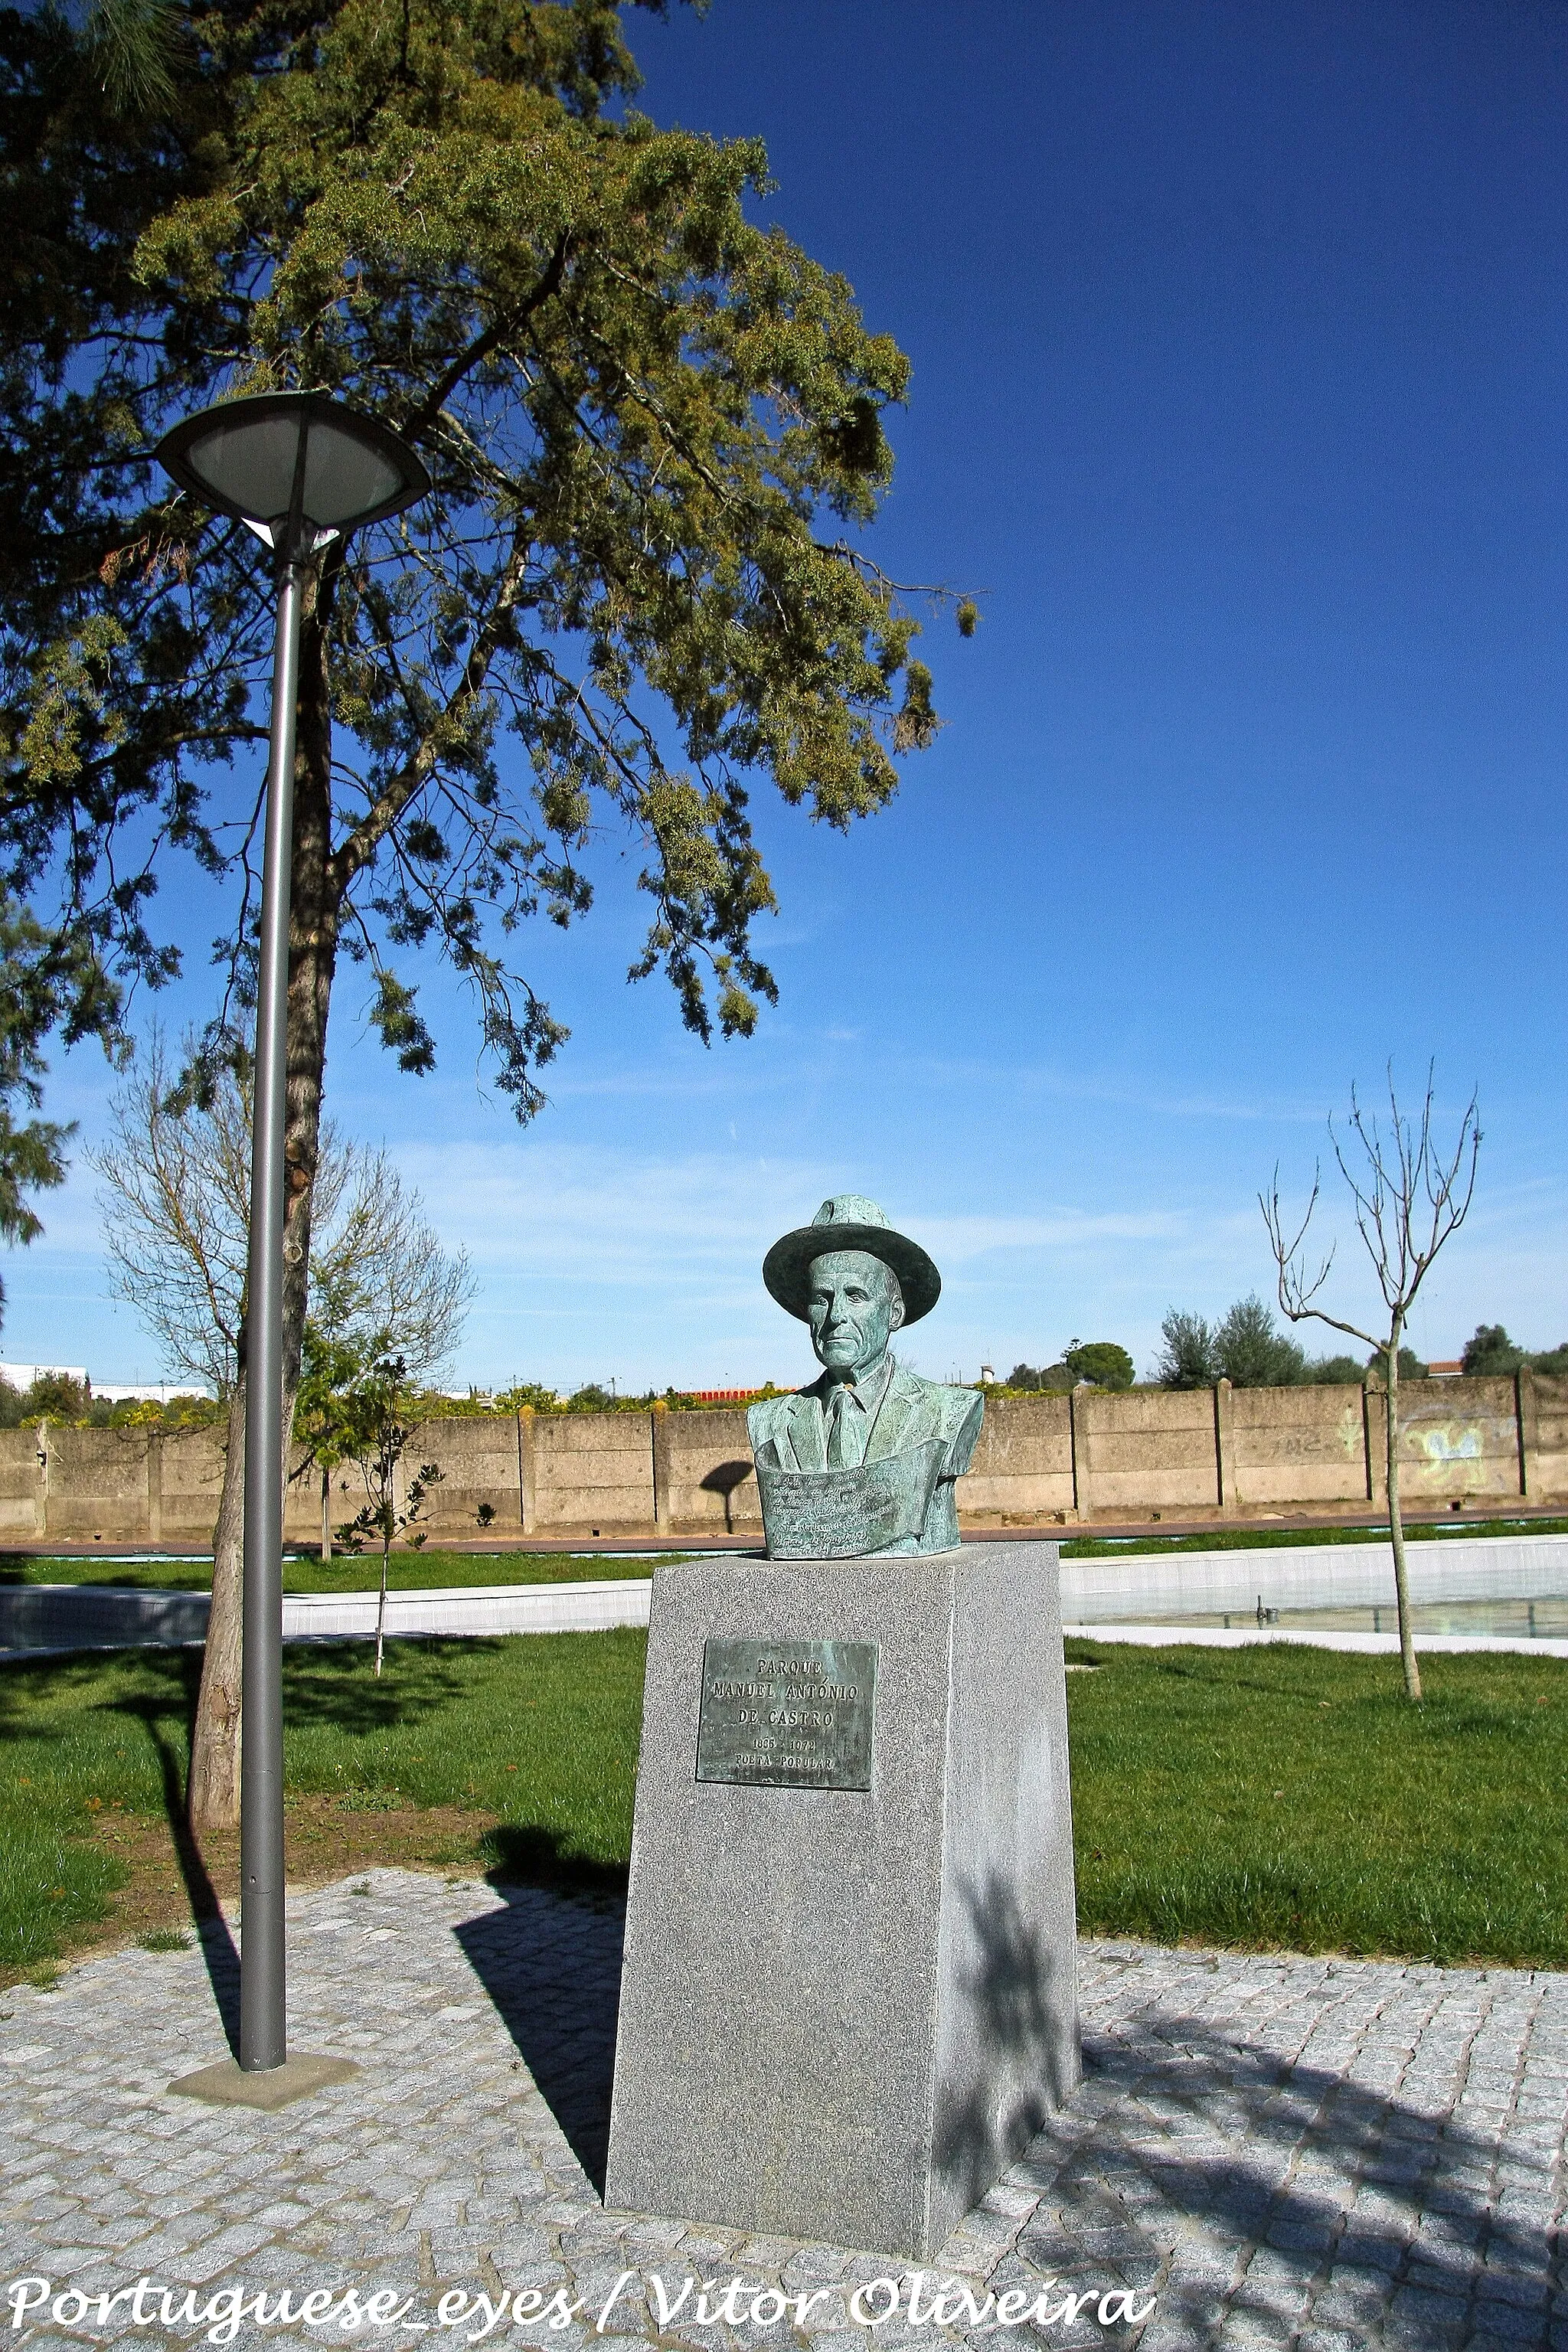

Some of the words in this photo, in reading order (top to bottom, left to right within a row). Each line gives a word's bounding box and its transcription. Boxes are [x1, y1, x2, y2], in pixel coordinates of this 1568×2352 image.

[758, 1658, 824, 1674] PARQUE
[714, 1681, 776, 1699] MANUEL
[786, 1677, 858, 1700] ANTÓNIO
[739, 1710, 758, 1723] DE
[769, 1709, 833, 1726] CASTRO
[737, 1754, 771, 1766] POETA
[781, 1756, 832, 1769] POPULAR
